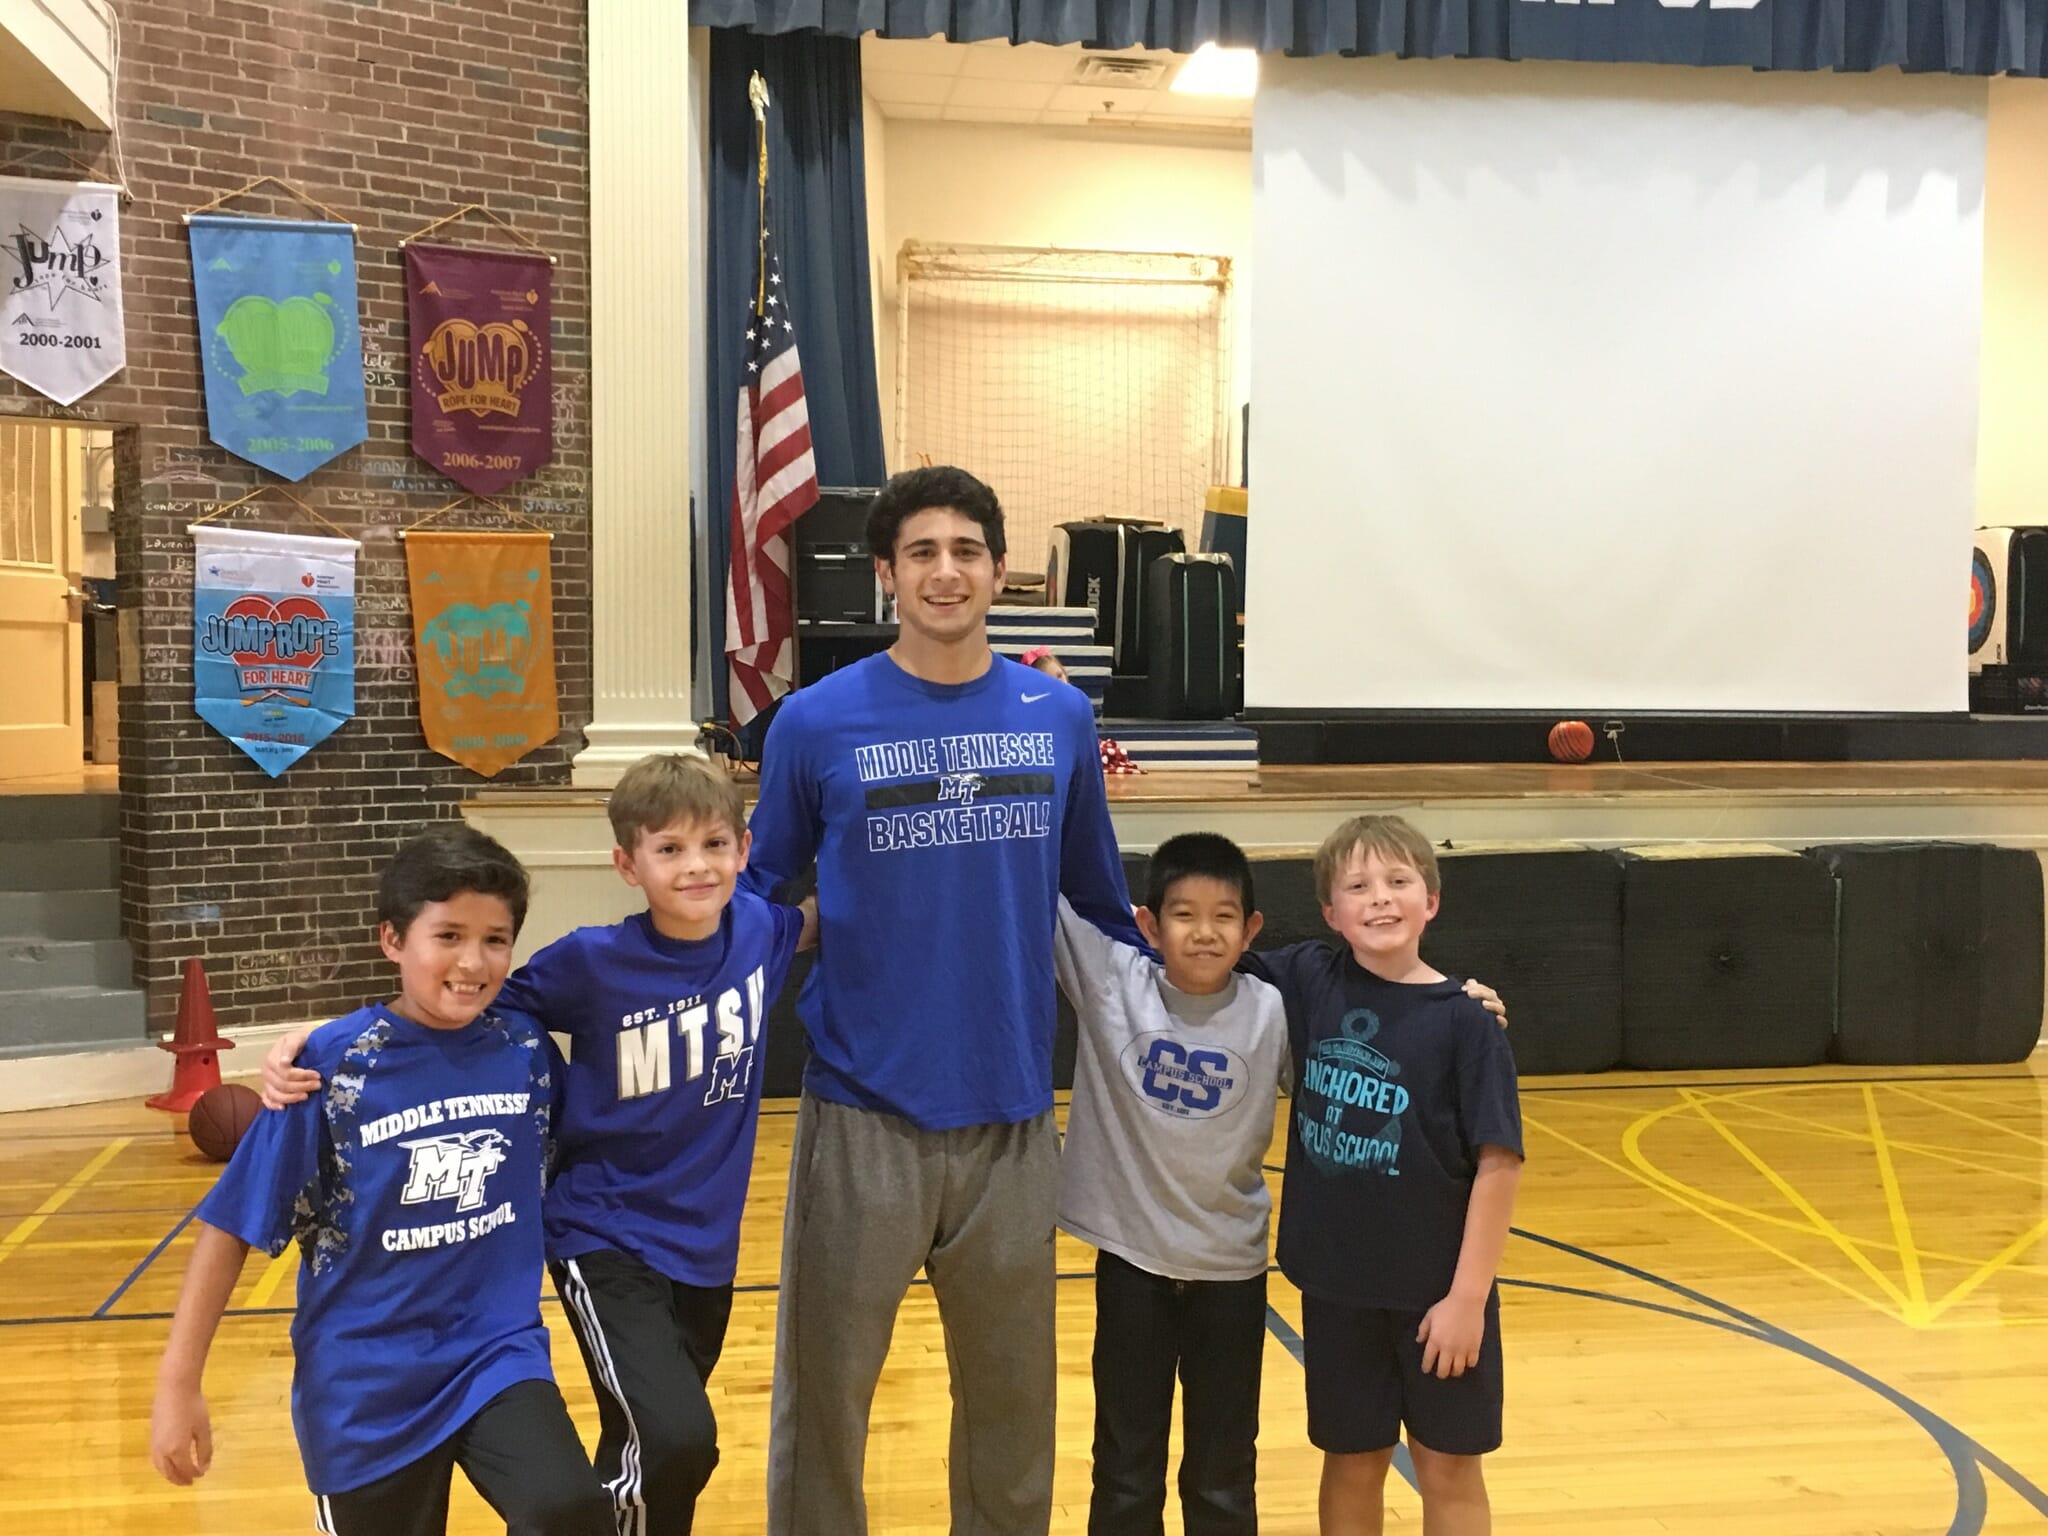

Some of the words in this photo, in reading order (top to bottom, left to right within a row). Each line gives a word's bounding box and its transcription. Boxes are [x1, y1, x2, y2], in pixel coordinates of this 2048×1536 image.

[20, 332, 102, 349] 2000-2001
[436, 329, 524, 394] JUMP
[442, 394, 467, 406] ROPE
[470, 394, 489, 405] FOR
[489, 397, 518, 413] HEART
[443, 452, 521, 470] 2006-2007
[202, 615, 275, 656] JUMP
[274, 614, 340, 659] ROPE
[243, 671, 267, 687] FOR
[271, 670, 312, 687] HEART
[856, 738, 939, 782] MIDDLE
[941, 732, 1055, 772] TENNESSEE
[867, 802, 1051, 852] BASKETBALL
[668, 994, 702, 1014] 1911
[1138, 1056, 1186, 1081] CAMPUS
[1187, 1072, 1232, 1089] SCHOOL
[1142, 1038, 1229, 1111] CS
[359, 1099, 445, 1148] MIDDLE
[1325, 1105, 1344, 1125] AT
[382, 1219, 466, 1252] CAMPUS
